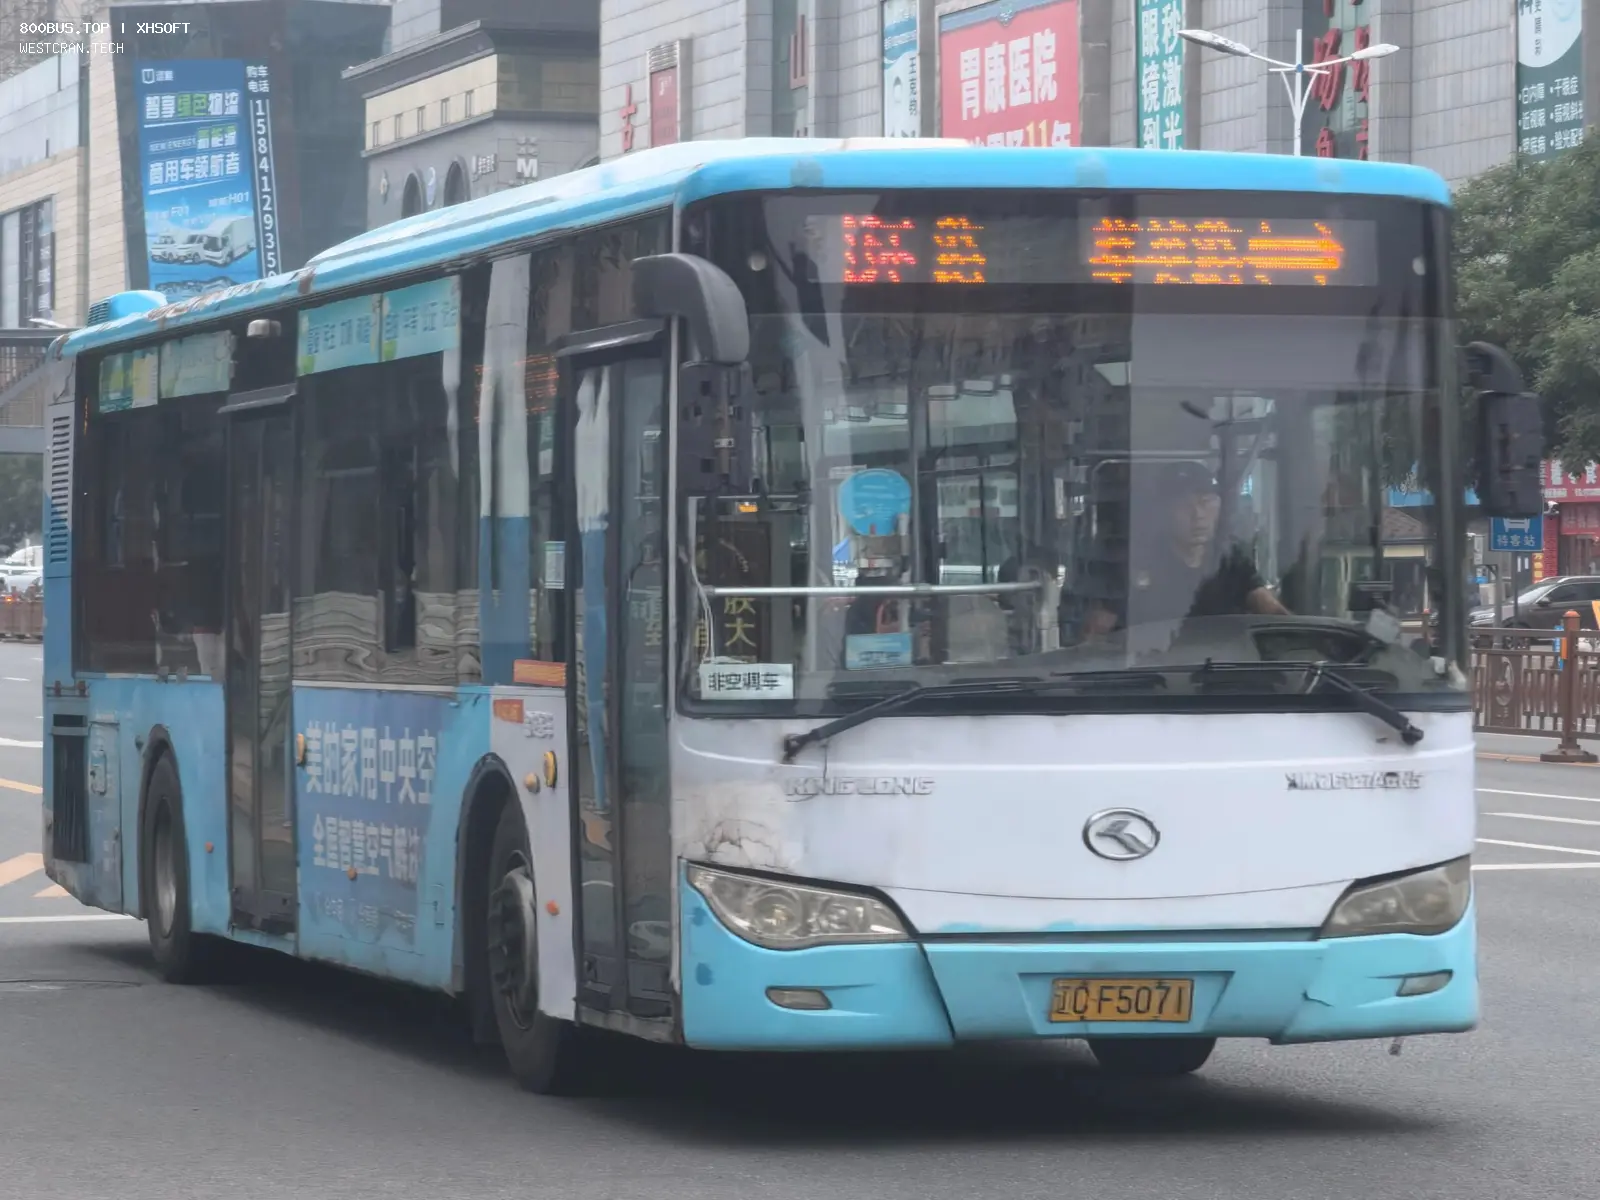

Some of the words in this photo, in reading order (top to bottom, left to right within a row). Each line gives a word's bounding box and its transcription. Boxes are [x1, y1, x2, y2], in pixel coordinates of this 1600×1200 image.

[960, 28, 1057, 120] 胃康医院
[1141, 0, 1160, 150] 眼镜到
[254, 99, 278, 279] 158412935
[708, 671, 783, 692] 非空调车
[305, 720, 437, 805] 美的家用中央空
